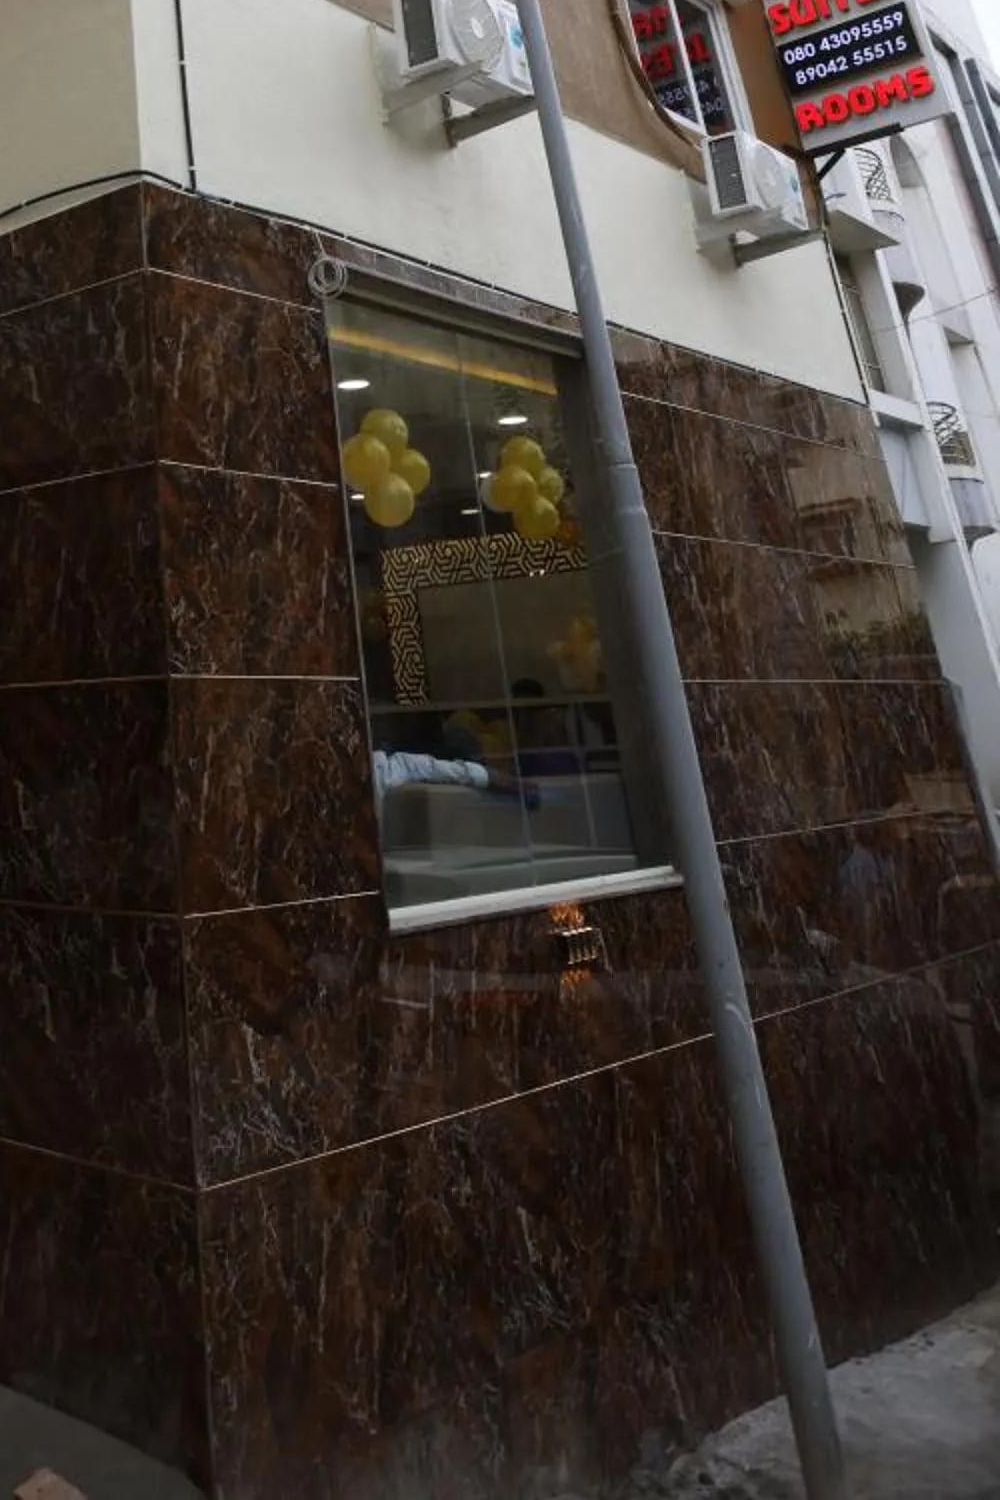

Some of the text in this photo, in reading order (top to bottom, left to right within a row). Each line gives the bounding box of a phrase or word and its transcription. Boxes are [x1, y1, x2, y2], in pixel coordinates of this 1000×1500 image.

[784, 10, 904, 66] 080 43095559
[795, 36, 908, 86] 89042 55515
[794, 65, 935, 135] ROOMS
